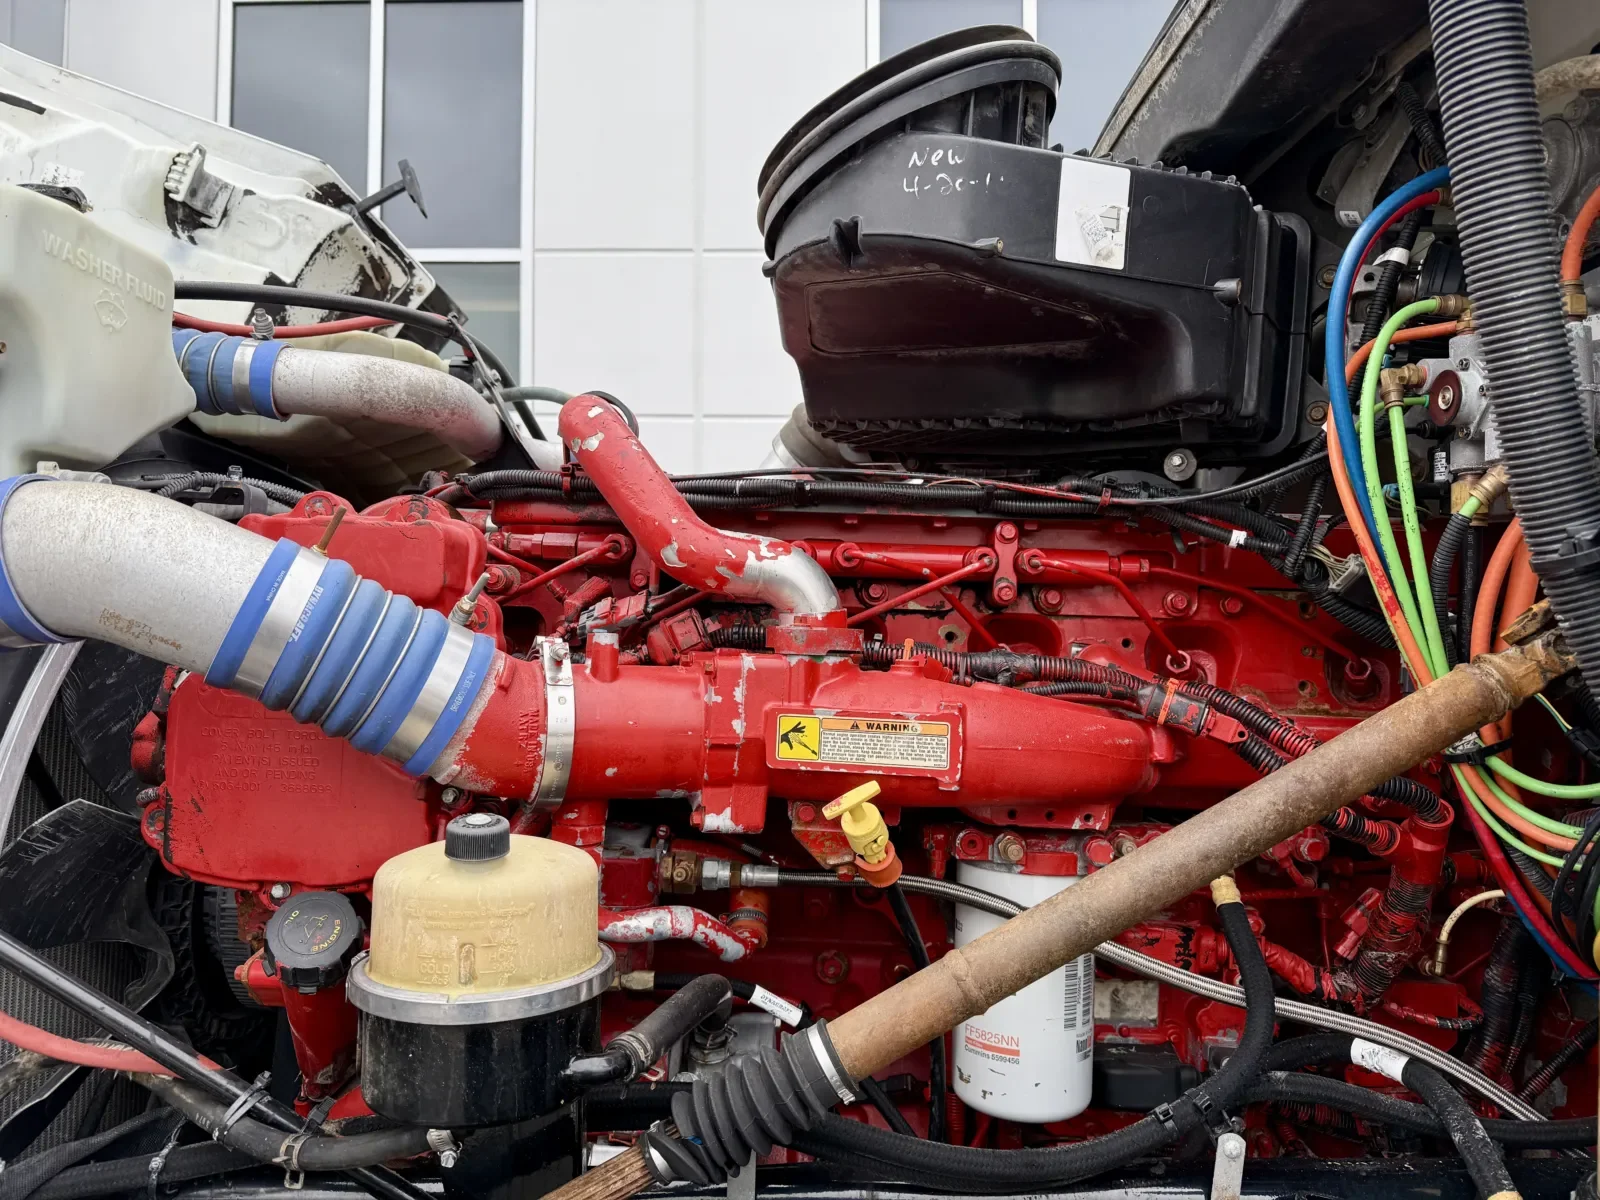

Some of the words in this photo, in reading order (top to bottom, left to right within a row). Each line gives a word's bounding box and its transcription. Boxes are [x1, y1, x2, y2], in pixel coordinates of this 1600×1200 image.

[43, 230, 124, 289] WASHER
[126, 272, 168, 312] FLUID
[290, 585, 325, 643] DYNACRAFT
[201, 727, 241, 738] COVER
[248, 728, 277, 740] BOLT
[286, 730, 333, 740] TORQU
[866, 722, 918, 733] WARNING
[279, 755, 321, 768] ISSUED
[266, 769, 317, 781] PENDING
[283, 909, 300, 929] OIL
[311, 919, 342, 953] ENGINE
[419, 962, 451, 975] COLD
[964, 1023, 1020, 1048] FF5825NN
[964, 1044, 991, 1060] Cummins
